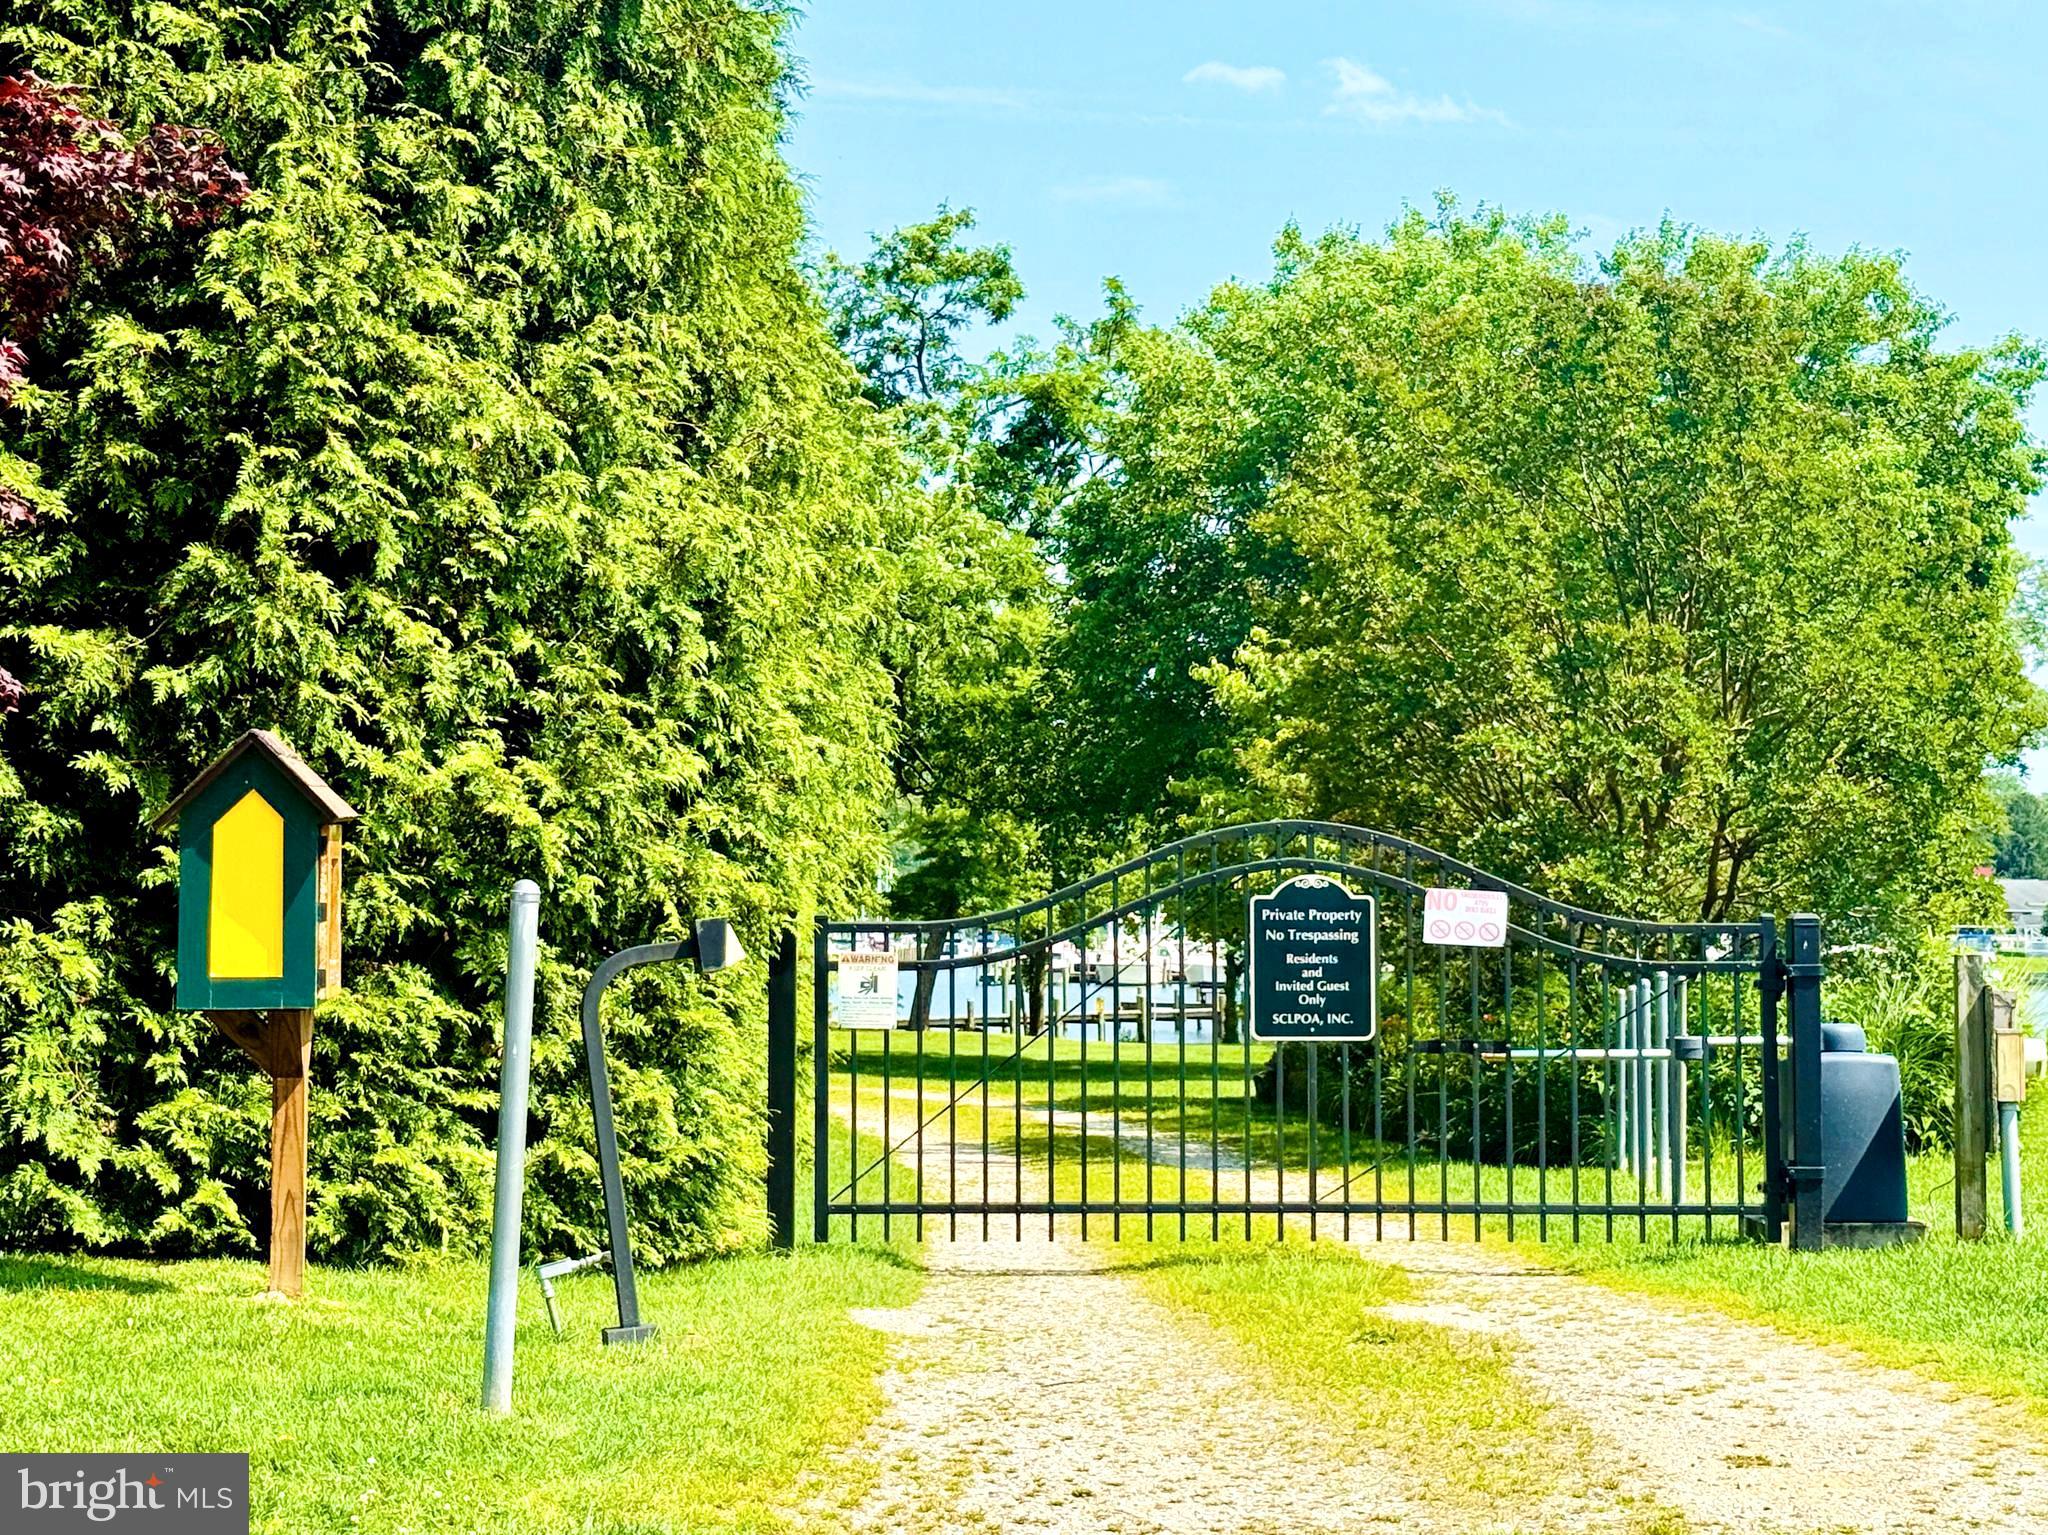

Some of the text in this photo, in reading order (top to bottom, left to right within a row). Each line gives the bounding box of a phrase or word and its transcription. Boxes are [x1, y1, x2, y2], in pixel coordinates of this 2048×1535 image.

[1428, 889, 1458, 911] NO
[1262, 909, 1362, 925] Private Property
[1266, 929, 1360, 944] No Trespassing
[851, 955, 895, 964] WARNING
[1286, 953, 1339, 964] Residents
[1301, 967, 1322, 978] and
[1275, 980, 1350, 991] Invited Guest
[1298, 994, 1326, 1008] Only
[1272, 1013, 1354, 1026] SCLPOA, INC.
